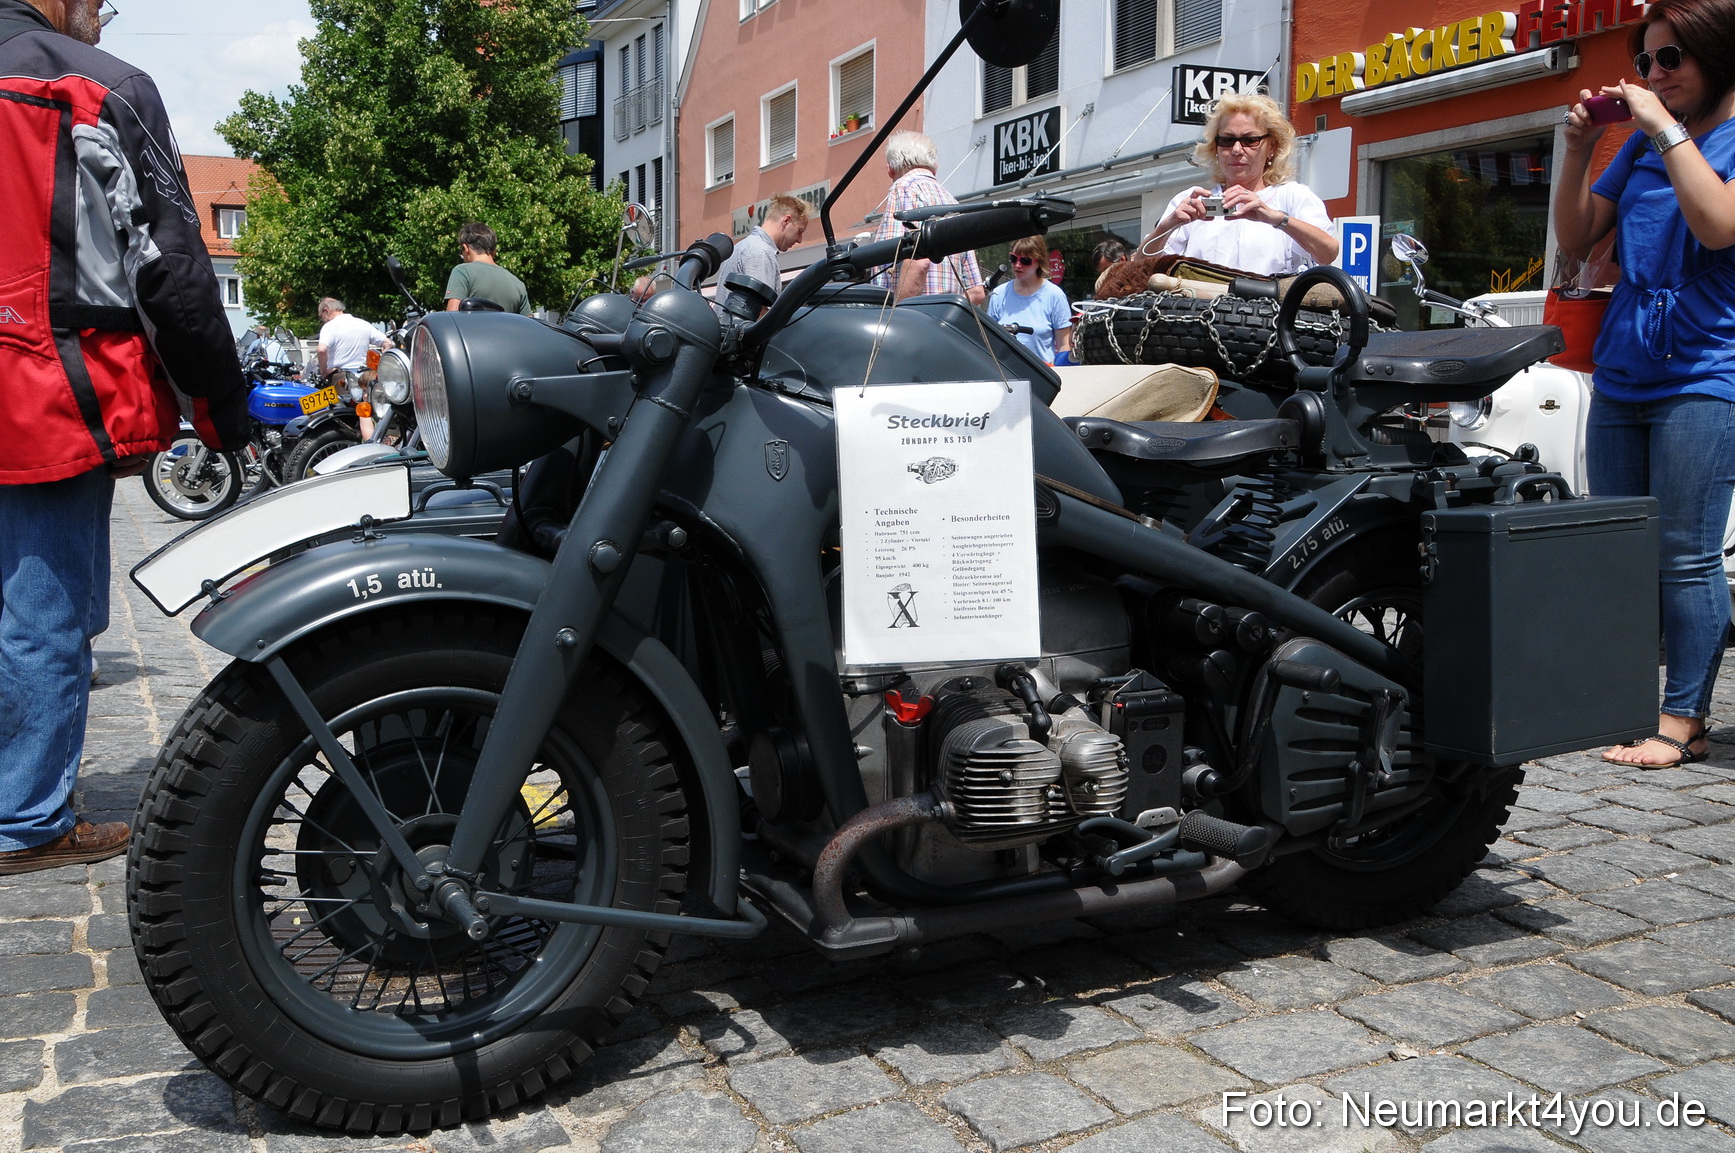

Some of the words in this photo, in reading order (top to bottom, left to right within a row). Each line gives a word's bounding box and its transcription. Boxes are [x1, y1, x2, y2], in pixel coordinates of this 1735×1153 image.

[1296, 52, 1364, 103] DER
[1364, 11, 1516, 88] BÄCKER
[1185, 69, 1262, 100] KBK
[1000, 112, 1050, 160] KBK
[1350, 232, 1367, 266] P
[887, 412, 990, 430] Steckbrief
[901, 436, 938, 445] ZÜNDAPP
[944, 436, 954, 444] KS
[957, 435, 973, 443] 750
[874, 507, 919, 516] Technische
[874, 519, 910, 528] Angaben
[951, 513, 1011, 523] Besonderheiten
[1287, 535, 1318, 570] 2,75
[346, 573, 382, 600] 1,5
[397, 567, 443, 589] atü.
